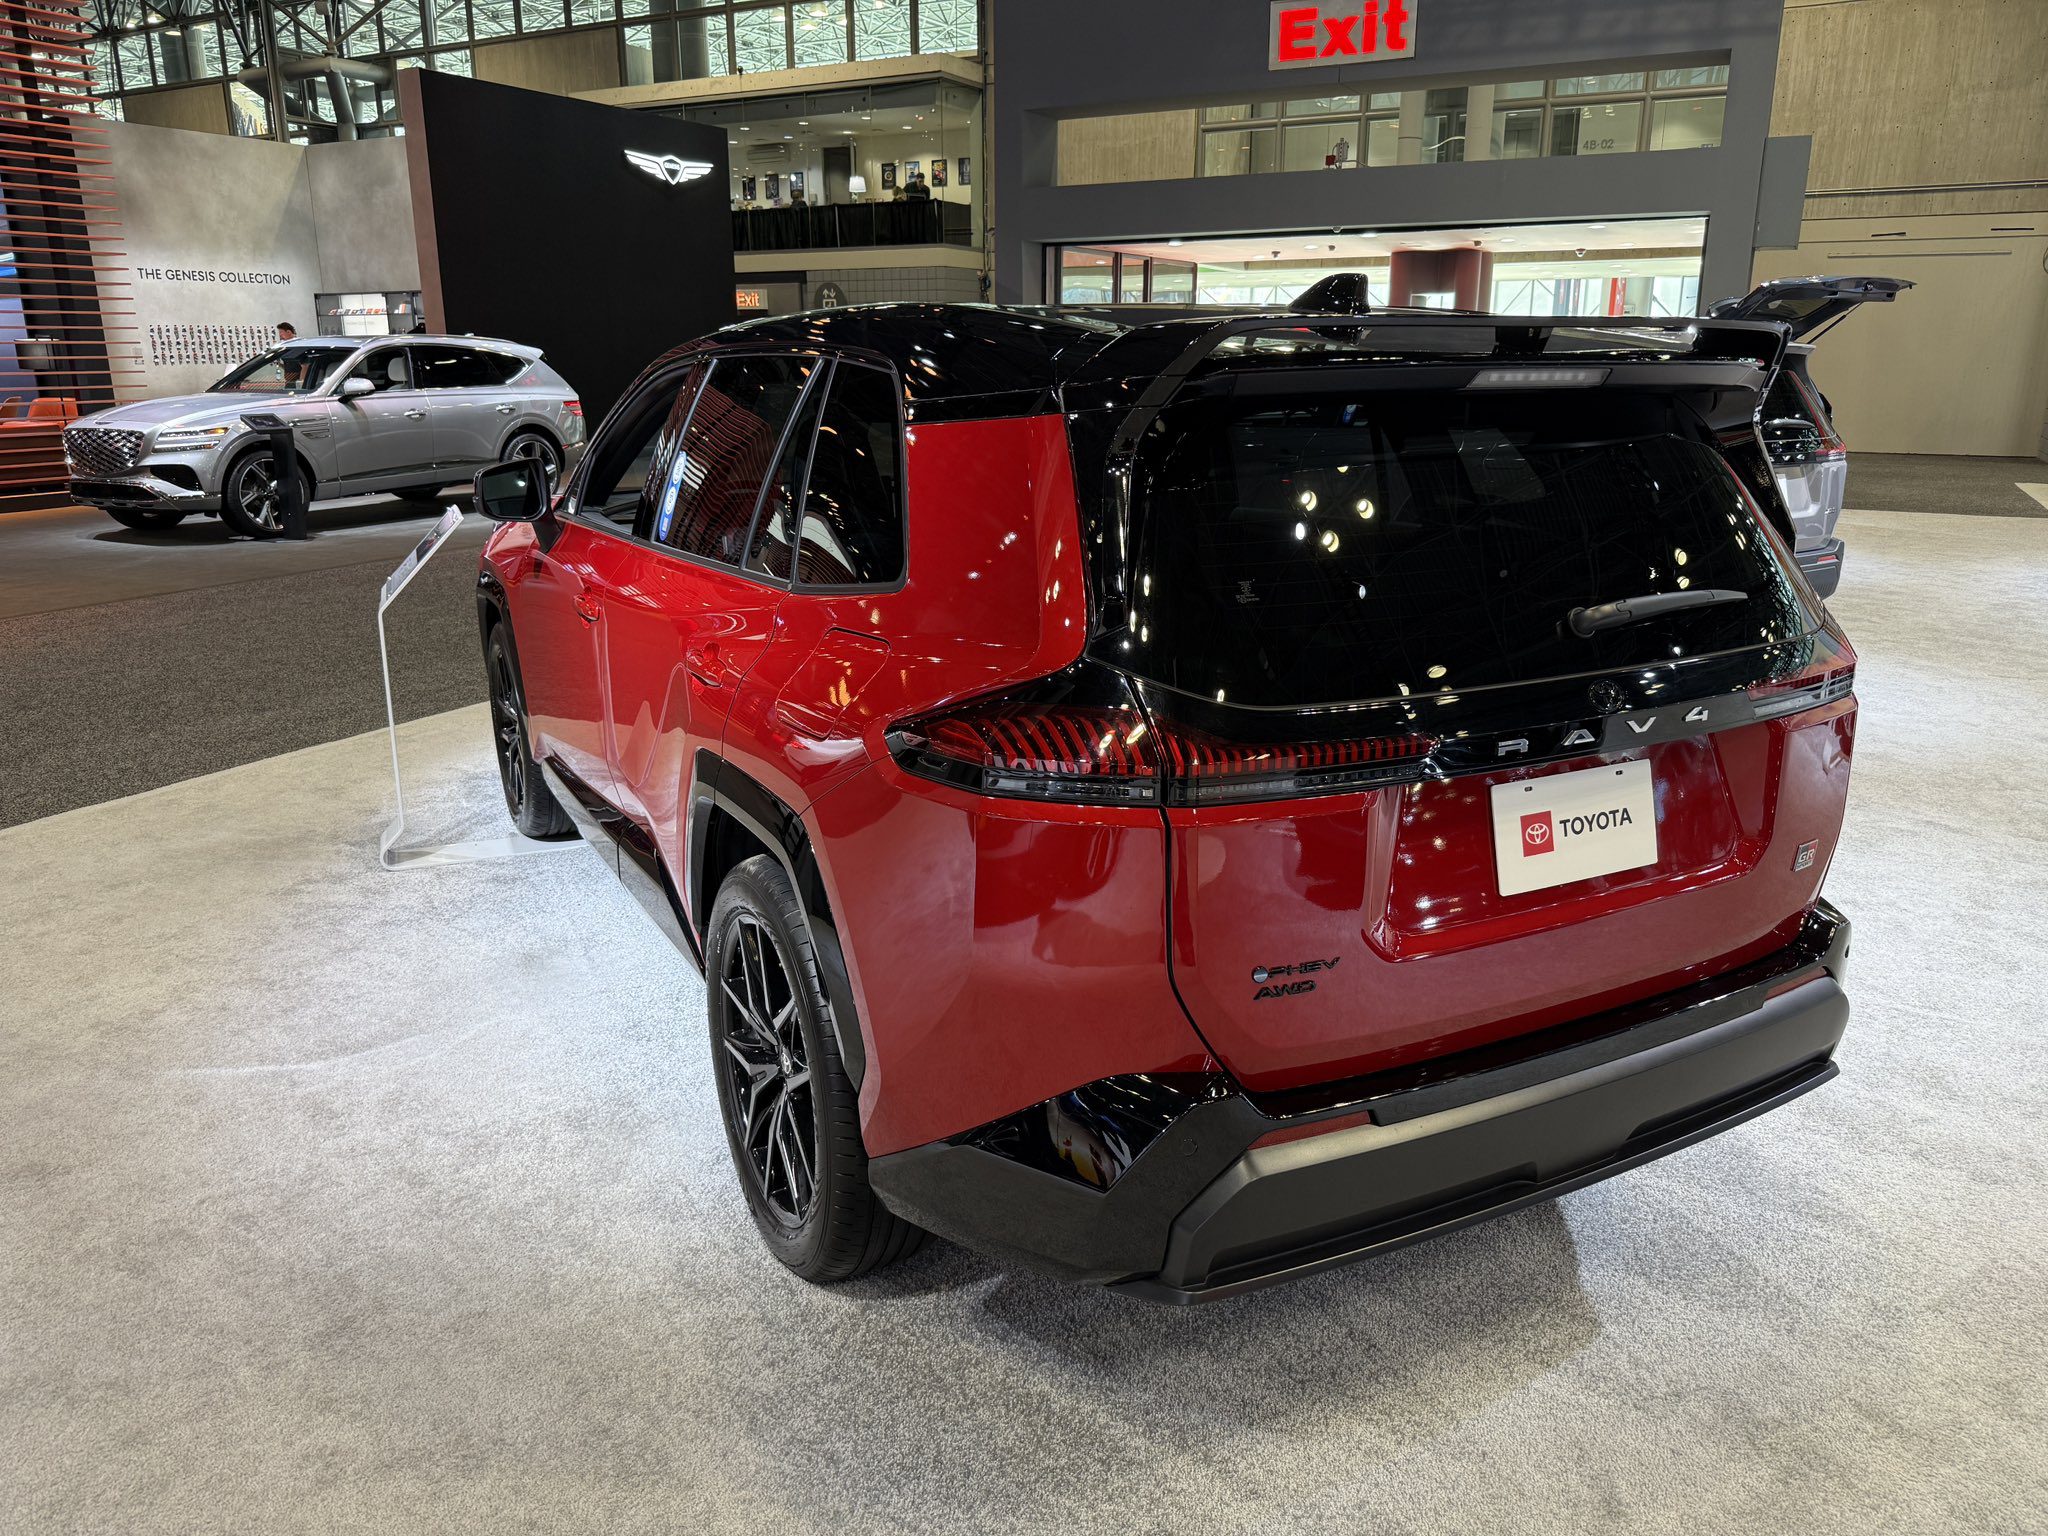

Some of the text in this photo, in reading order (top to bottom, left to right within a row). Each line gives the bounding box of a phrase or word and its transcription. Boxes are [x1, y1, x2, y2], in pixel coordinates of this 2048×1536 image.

[1279, 0, 1408, 62] Exit
[137, 268, 291, 285] THE GENESIS COLLECTION
[736, 291, 760, 307] Exit
[1497, 706, 1709, 757] RAV4
[1559, 807, 1633, 837] TOYOTA
[1798, 848, 1815, 863] GR
[1268, 956, 1341, 979] PHEV
[1253, 980, 1317, 1000] AWD
